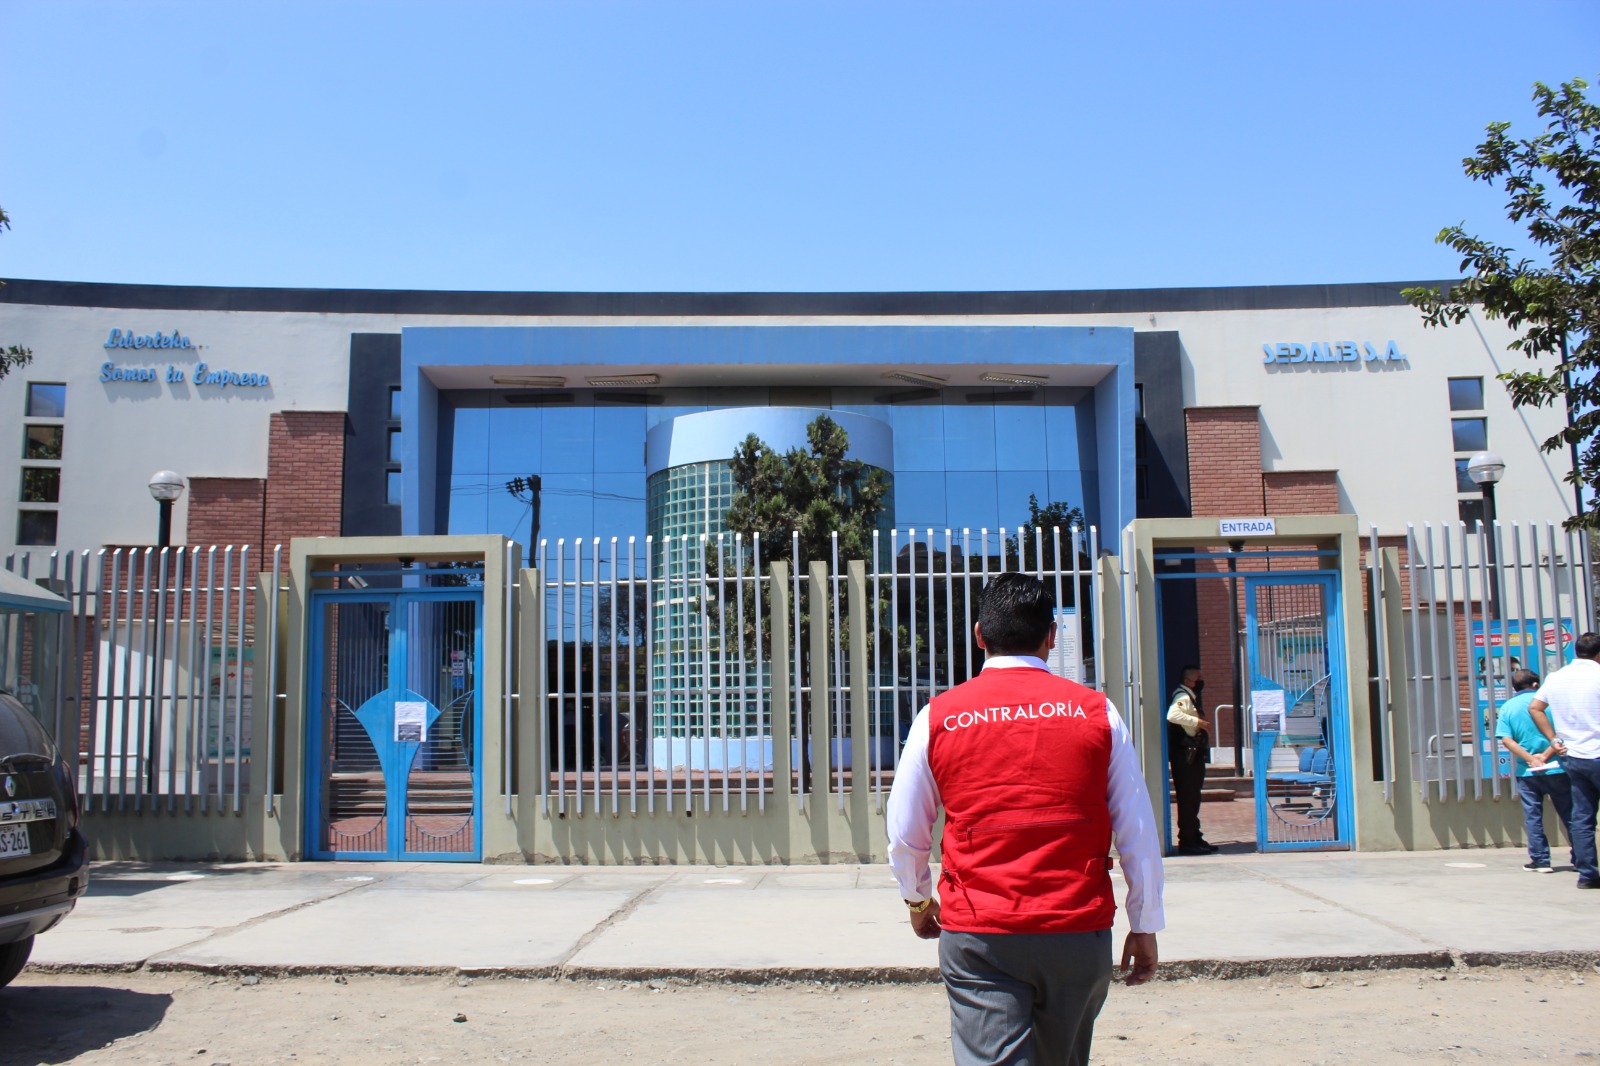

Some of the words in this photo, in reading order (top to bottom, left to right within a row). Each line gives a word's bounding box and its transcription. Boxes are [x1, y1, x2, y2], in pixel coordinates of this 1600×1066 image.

[1363, 340, 1407, 361] S.A.
[100, 361, 157, 383] Somos
[165, 364, 184, 383] tu
[193, 361, 270, 388] Empresa
[1221, 522, 1273, 533] ENTRADA
[943, 700, 1087, 731] CONTRALORÍA
[0, 831, 29, 853] S-261
